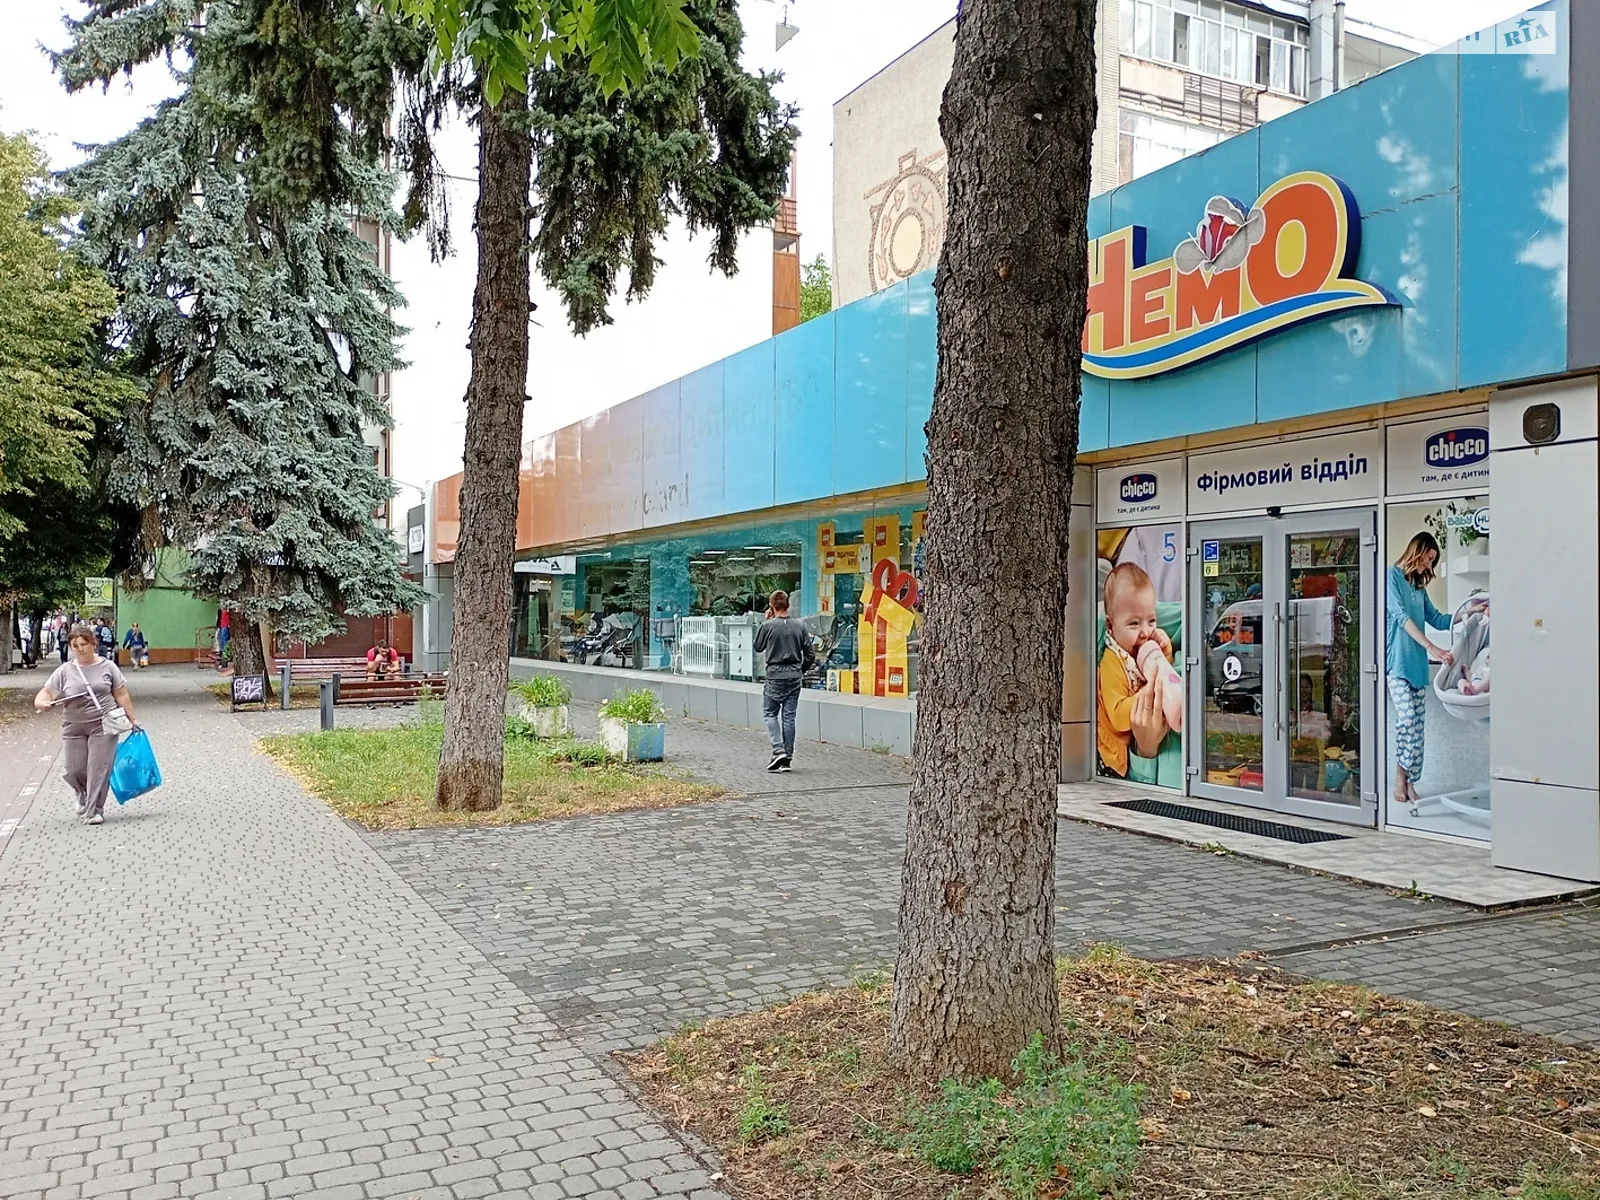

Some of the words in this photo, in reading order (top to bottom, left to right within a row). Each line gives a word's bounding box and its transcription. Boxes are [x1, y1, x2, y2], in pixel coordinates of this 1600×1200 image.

[1429, 432, 1485, 461] chicco
[1196, 462, 1293, 495] Фірмовий
[1300, 453, 1368, 483] відділ
[1421, 474, 1440, 483] там,
[1441, 473, 1453, 482] де
[1461, 469, 1490, 481] дитин
[1122, 476, 1155, 498] chicco
[1477, 514, 1490, 524] HU
[1163, 532, 1176, 562] 5
